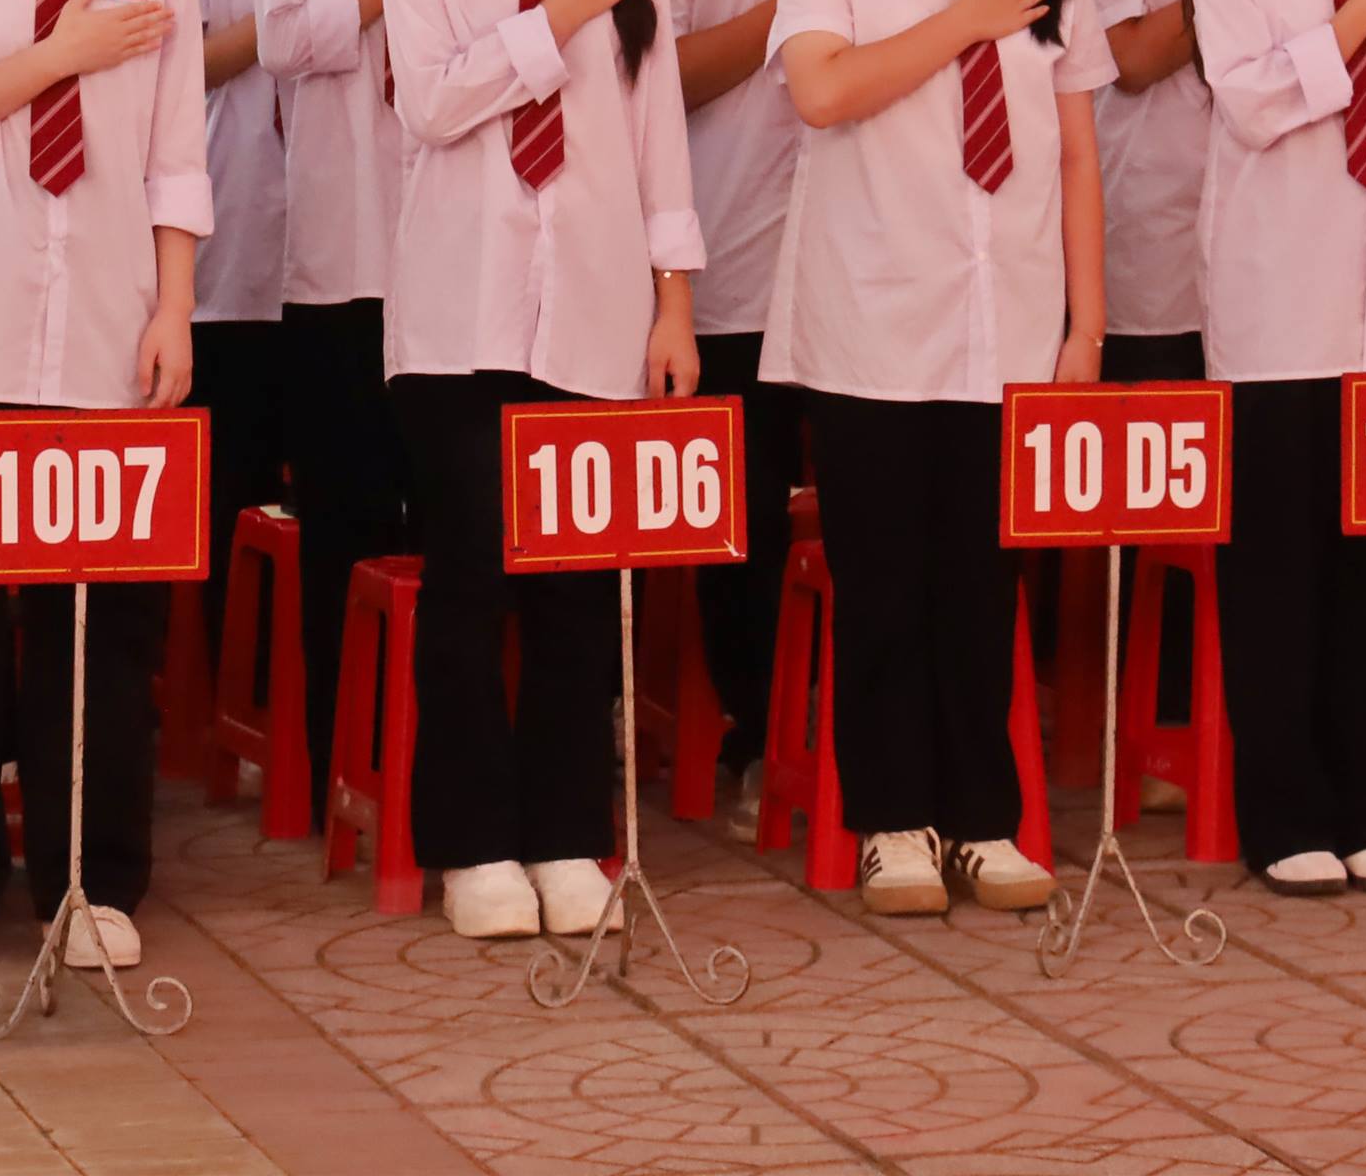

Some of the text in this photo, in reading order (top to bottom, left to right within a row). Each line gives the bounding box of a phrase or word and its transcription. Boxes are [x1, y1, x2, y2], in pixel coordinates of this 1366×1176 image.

[528, 437, 722, 536] 10 D6
[1024, 420, 1207, 513] 10 D5
